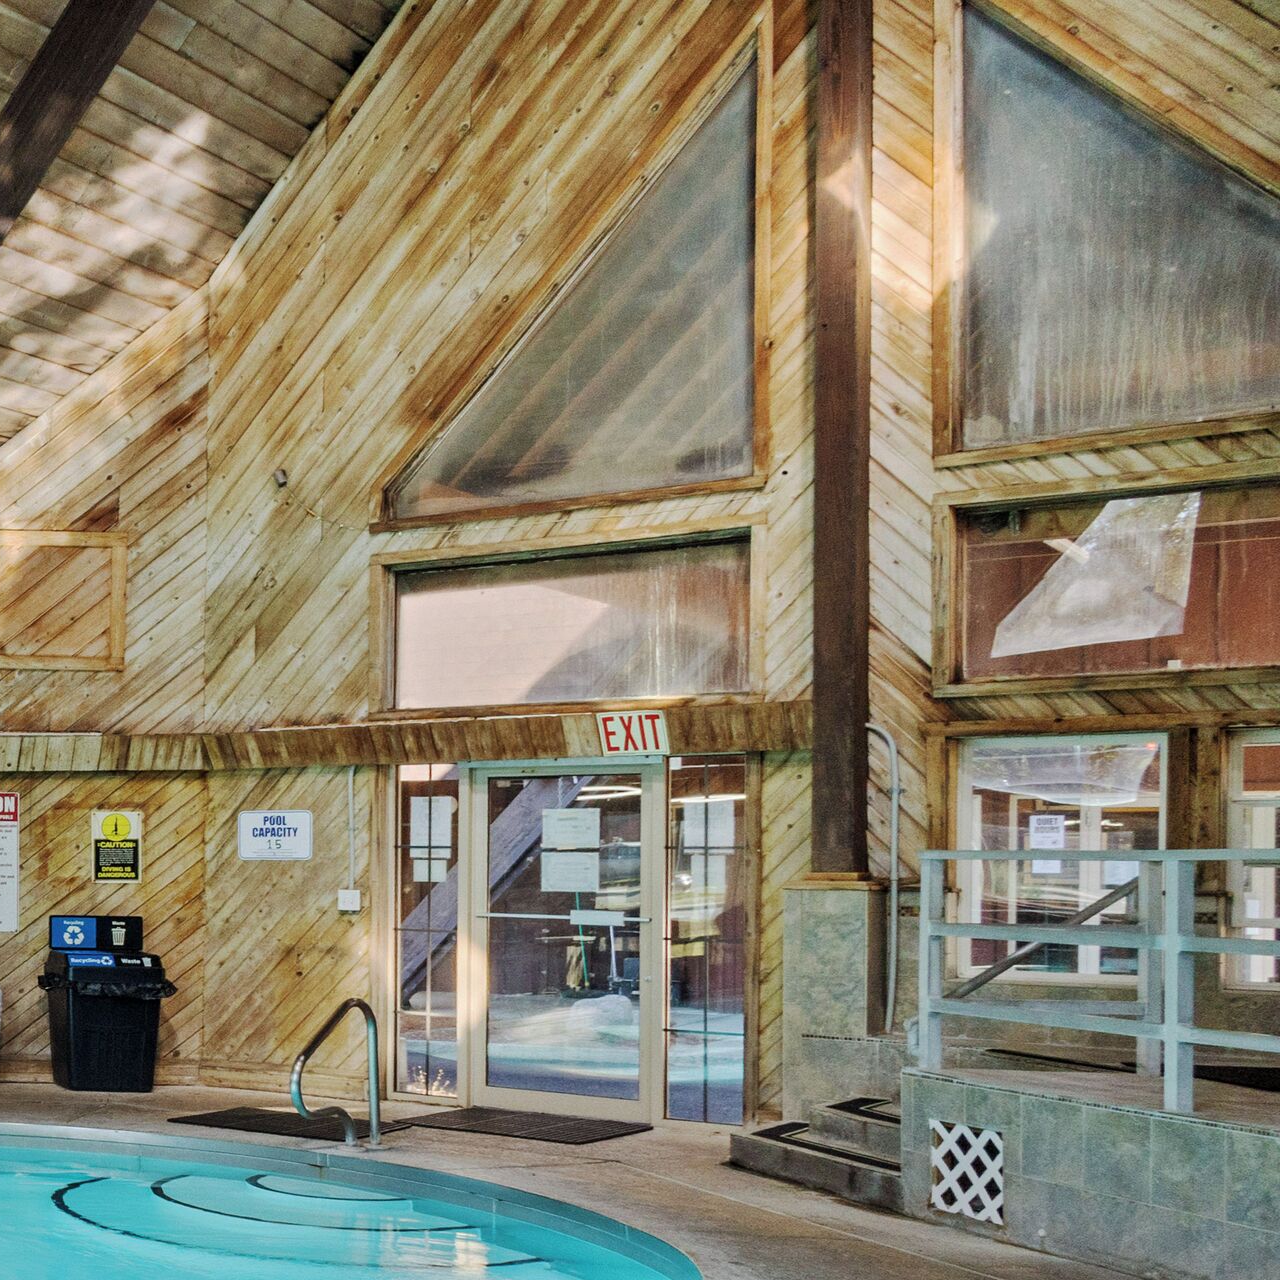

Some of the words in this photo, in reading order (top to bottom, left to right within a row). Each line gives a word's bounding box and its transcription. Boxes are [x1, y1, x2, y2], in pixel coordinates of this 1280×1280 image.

[601, 714, 660, 752] EXIT
[263, 815, 287, 826] POOL
[252, 827, 298, 838] CAPACITY
[267, 839, 282, 850] 15
[70, 957, 101, 965] Recycling
